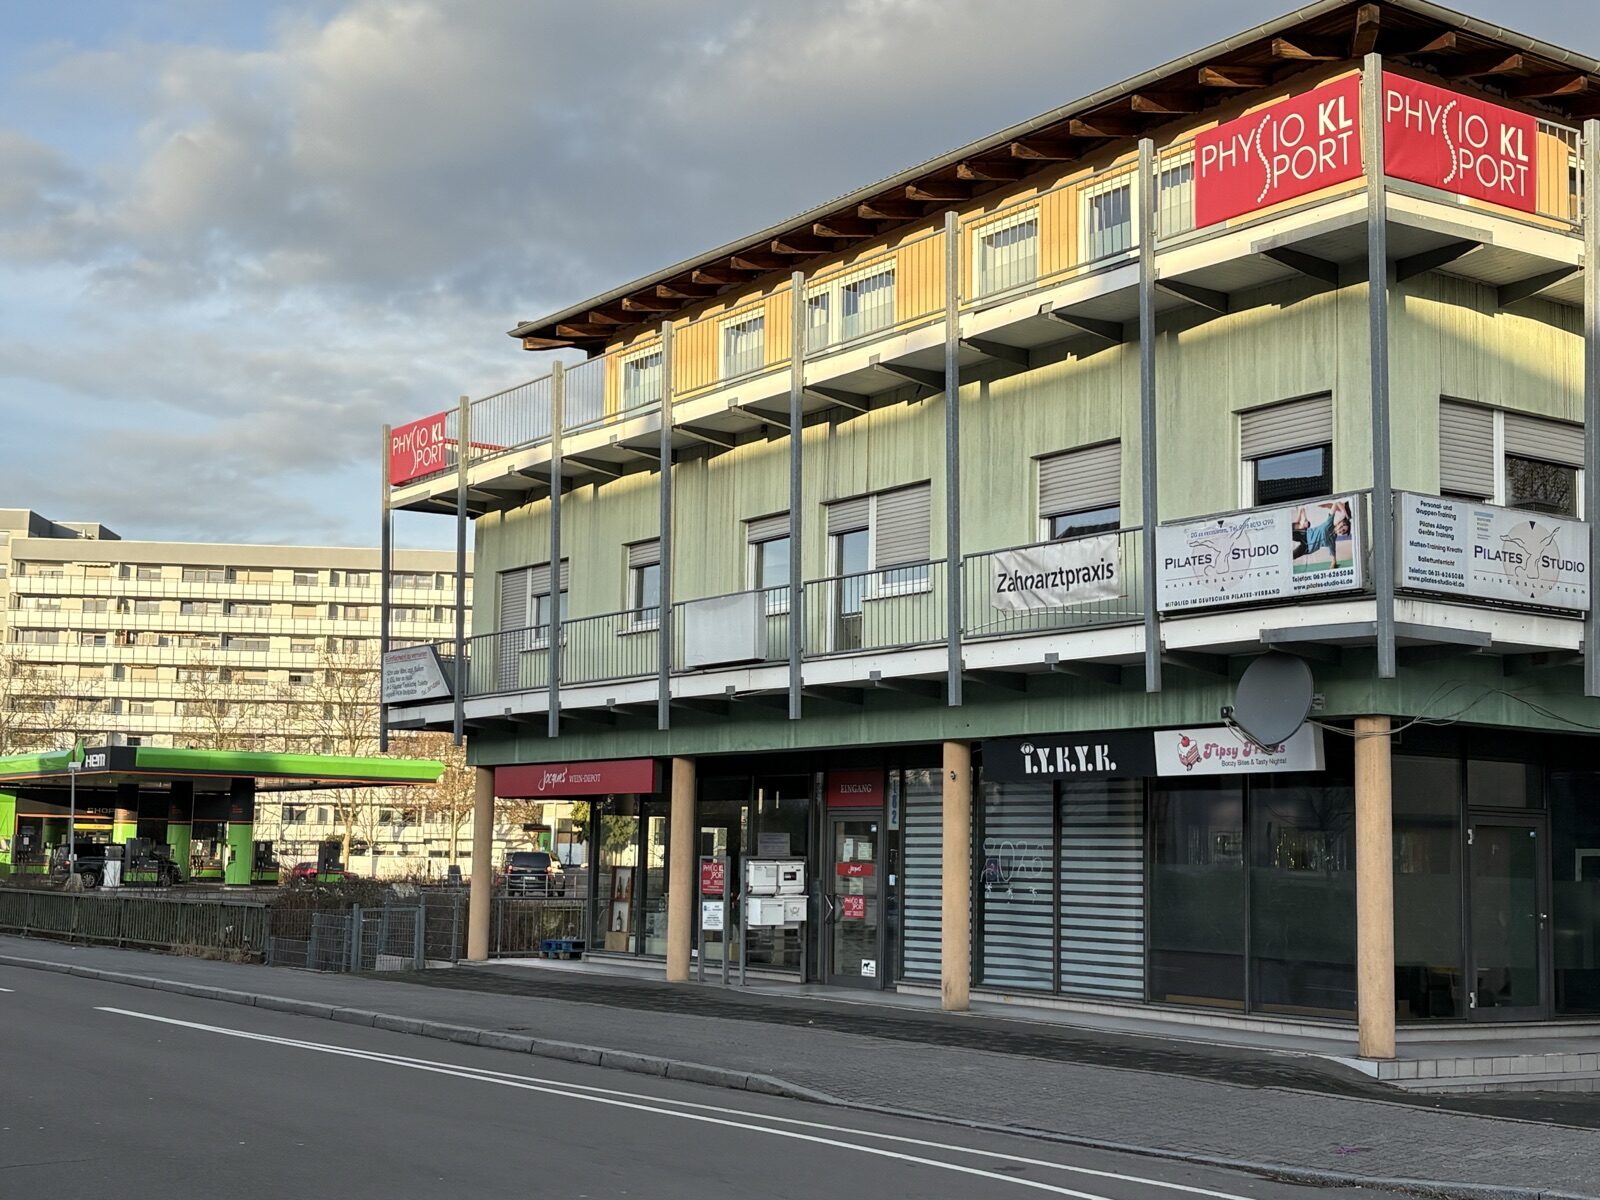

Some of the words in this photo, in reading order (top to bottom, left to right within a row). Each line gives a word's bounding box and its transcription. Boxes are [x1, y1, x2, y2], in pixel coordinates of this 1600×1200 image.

[1318, 97, 1353, 137] KL
[1500, 123, 1530, 163] KL
[431, 422, 444, 444] KL
[1418, 528, 1435, 537] Geräte
[1435, 531, 1455, 541] Training
[1419, 520, 1435, 529] Pilates
[1436, 523, 1453, 532] Allegro
[1164, 552, 1213, 570] PILATES
[1231, 544, 1279, 560] STUDIO
[1446, 546, 1463, 554] Kreativ
[1474, 545, 1523, 564] PILATES
[1541, 555, 1585, 573] STUDIO
[996, 557, 1115, 594] Zahnarztpraxis
[1203, 742, 1238, 760] Tipsy
[569, 773, 601, 784] WEIN-DEPOT
[840, 784, 872, 793] EINGANG
